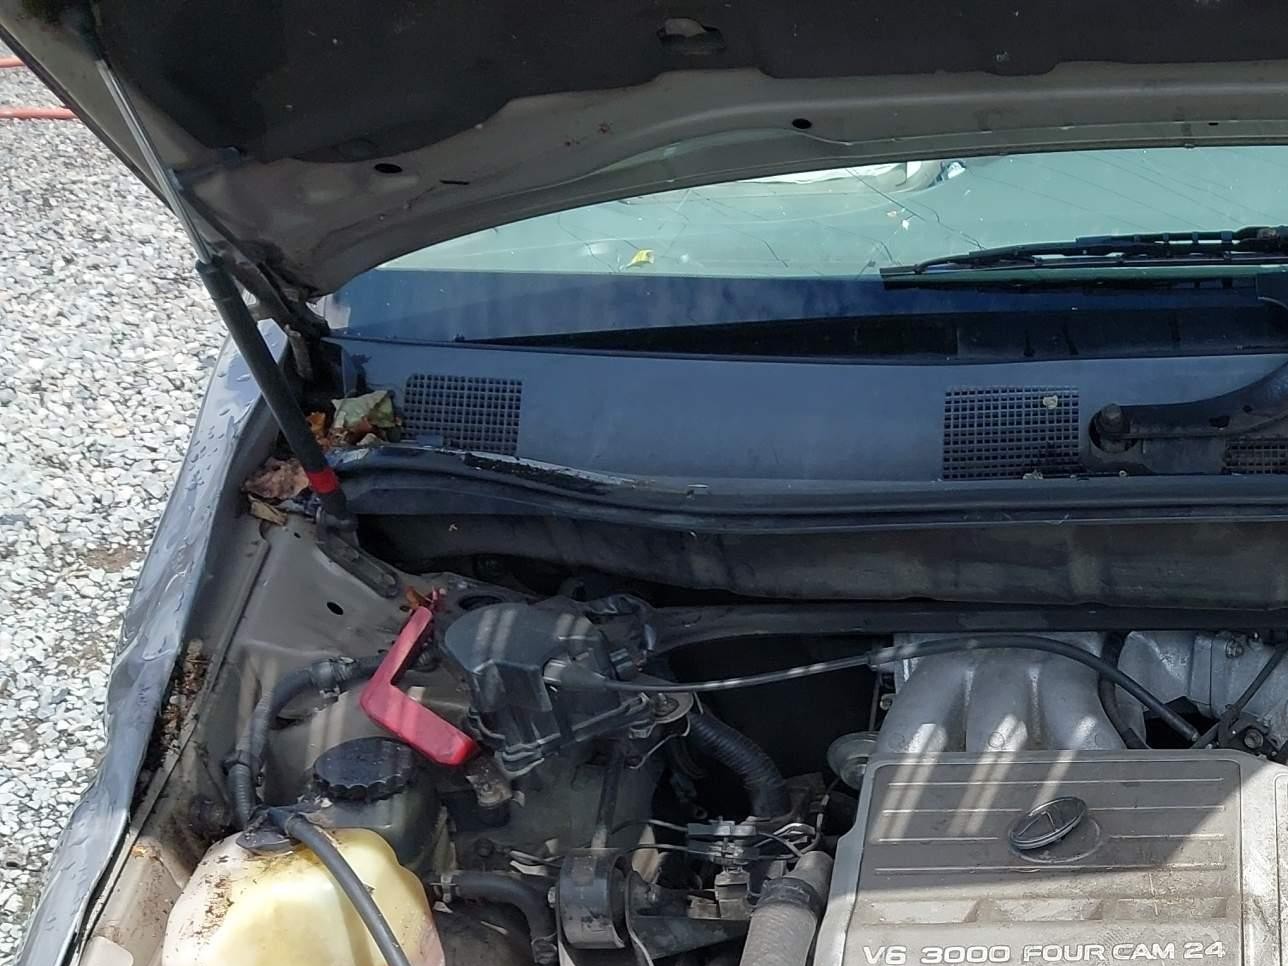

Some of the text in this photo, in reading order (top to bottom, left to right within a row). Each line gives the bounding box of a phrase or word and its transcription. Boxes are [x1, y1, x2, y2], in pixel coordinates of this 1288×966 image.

[863, 940, 1226, 965] V6 3000 FOUR CAM 24
